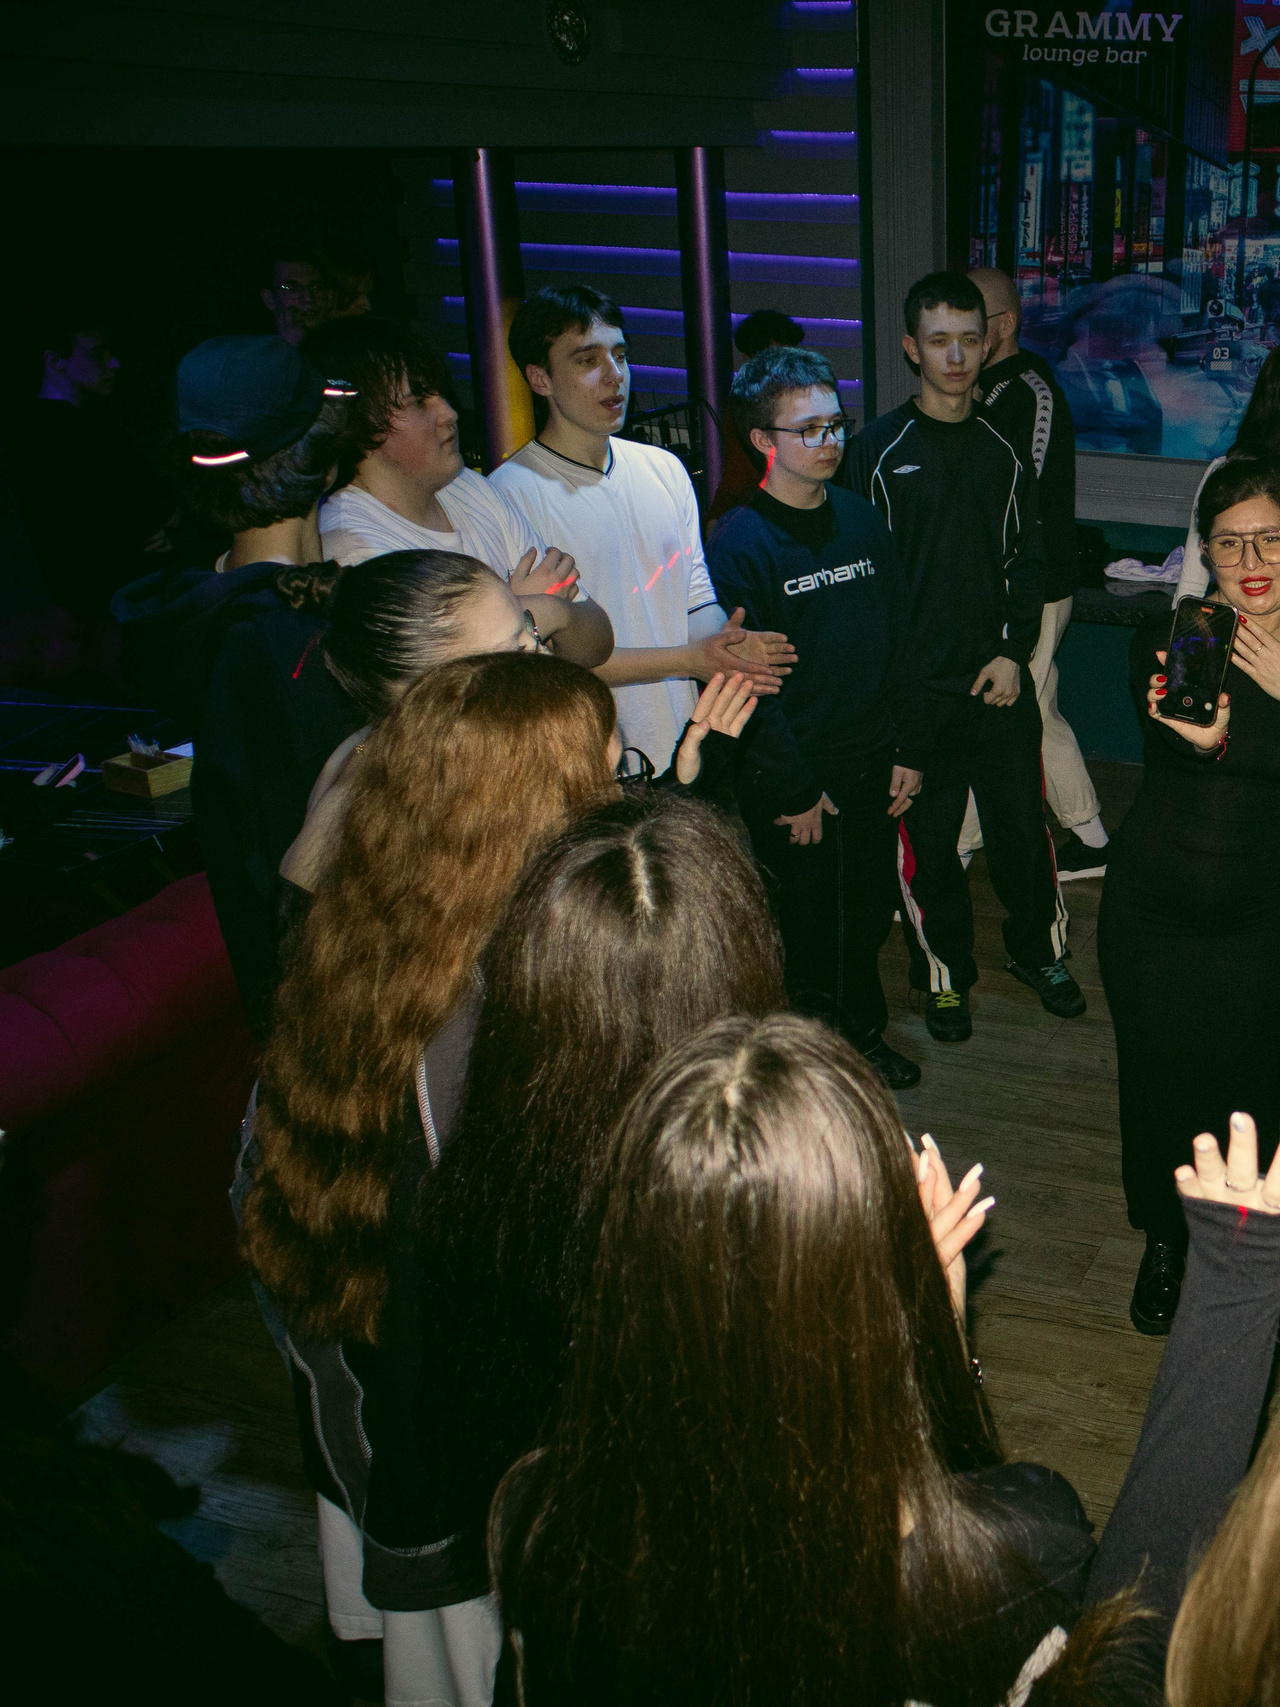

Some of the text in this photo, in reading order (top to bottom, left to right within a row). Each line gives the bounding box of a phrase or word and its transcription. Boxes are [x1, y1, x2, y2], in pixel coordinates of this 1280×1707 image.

[984, 8, 1184, 42] GRAMMY
[1022, 44, 1148, 67] lounge bar
[1212, 347, 1230, 360] 03
[783, 557, 872, 596] carhartt
